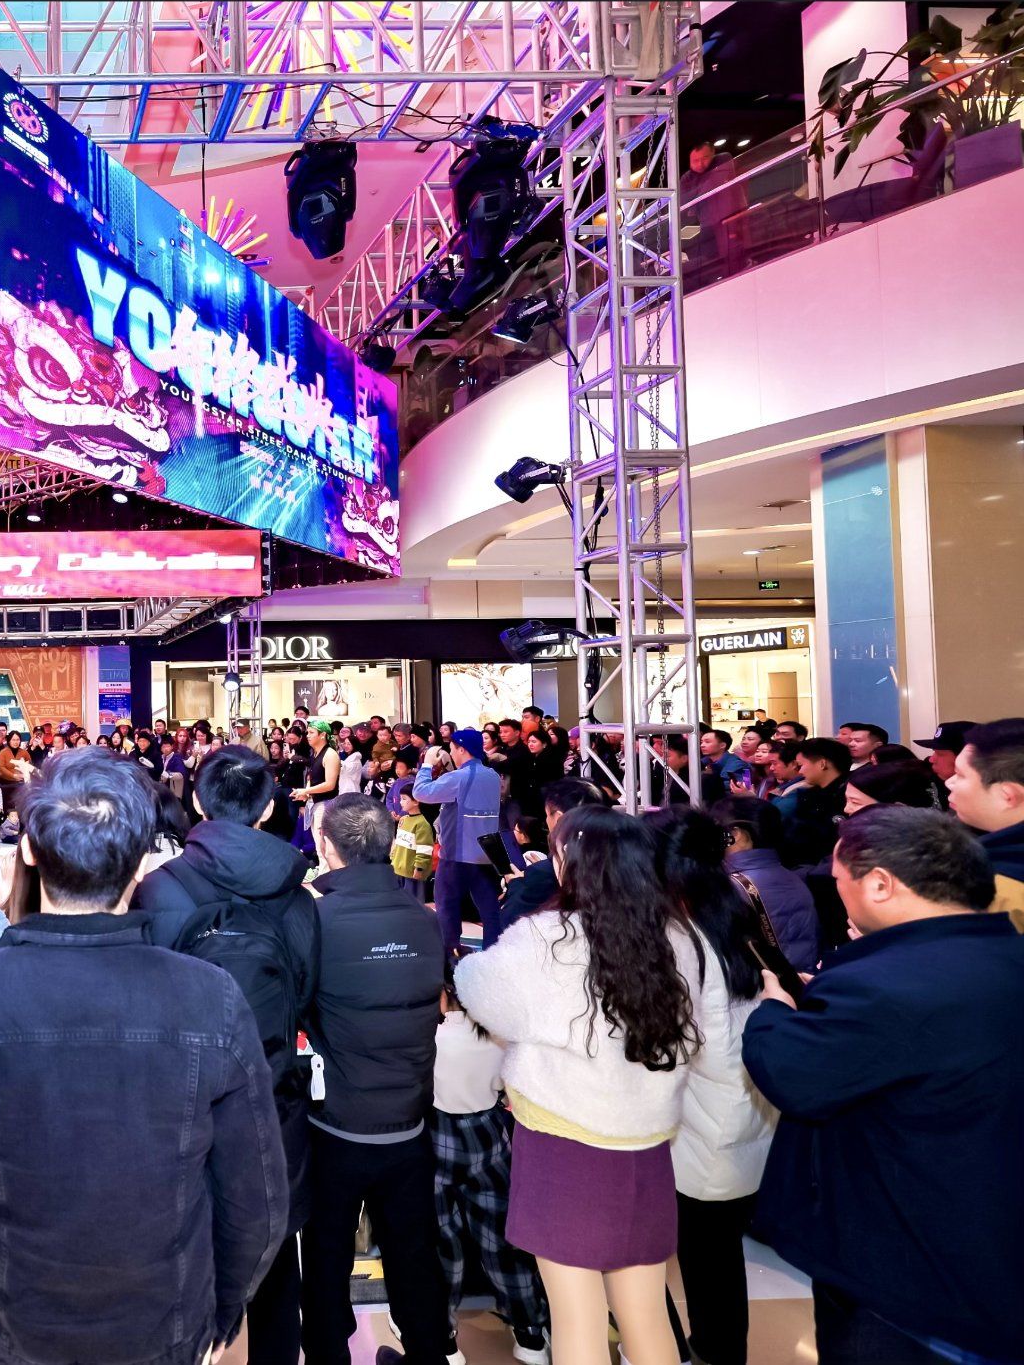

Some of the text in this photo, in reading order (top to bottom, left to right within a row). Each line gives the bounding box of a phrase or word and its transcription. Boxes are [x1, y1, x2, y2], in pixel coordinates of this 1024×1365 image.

[247, 424, 284, 449] STREE
[286, 444, 319, 469] DANCE
[322, 464, 354, 485] STUDIO
[3, 584, 48, 597] MALL
[254, 636, 333, 661] DIOR
[701, 631, 783, 652] GUERLAIN
